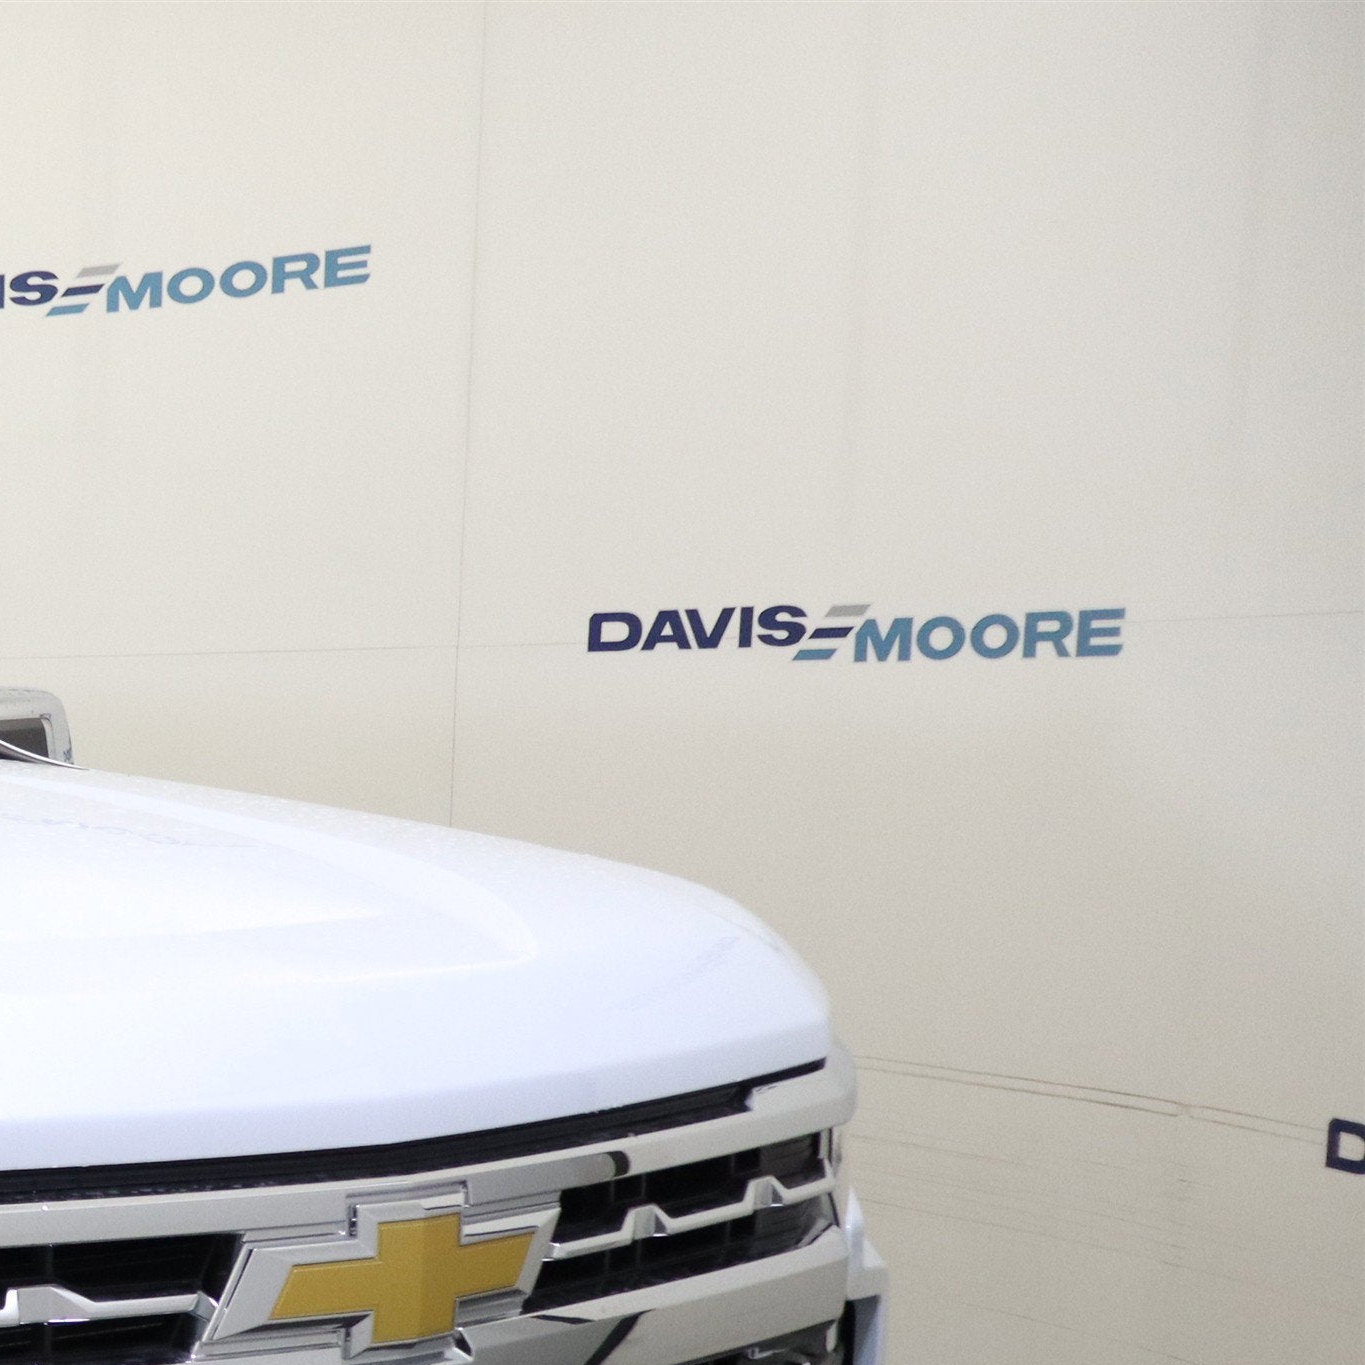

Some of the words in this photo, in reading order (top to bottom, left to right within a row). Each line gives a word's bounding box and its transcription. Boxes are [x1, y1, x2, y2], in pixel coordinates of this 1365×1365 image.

[105, 245, 371, 314] MOORE
[587, 604, 808, 653] DAVIS
[853, 607, 1127, 663] MOORE
